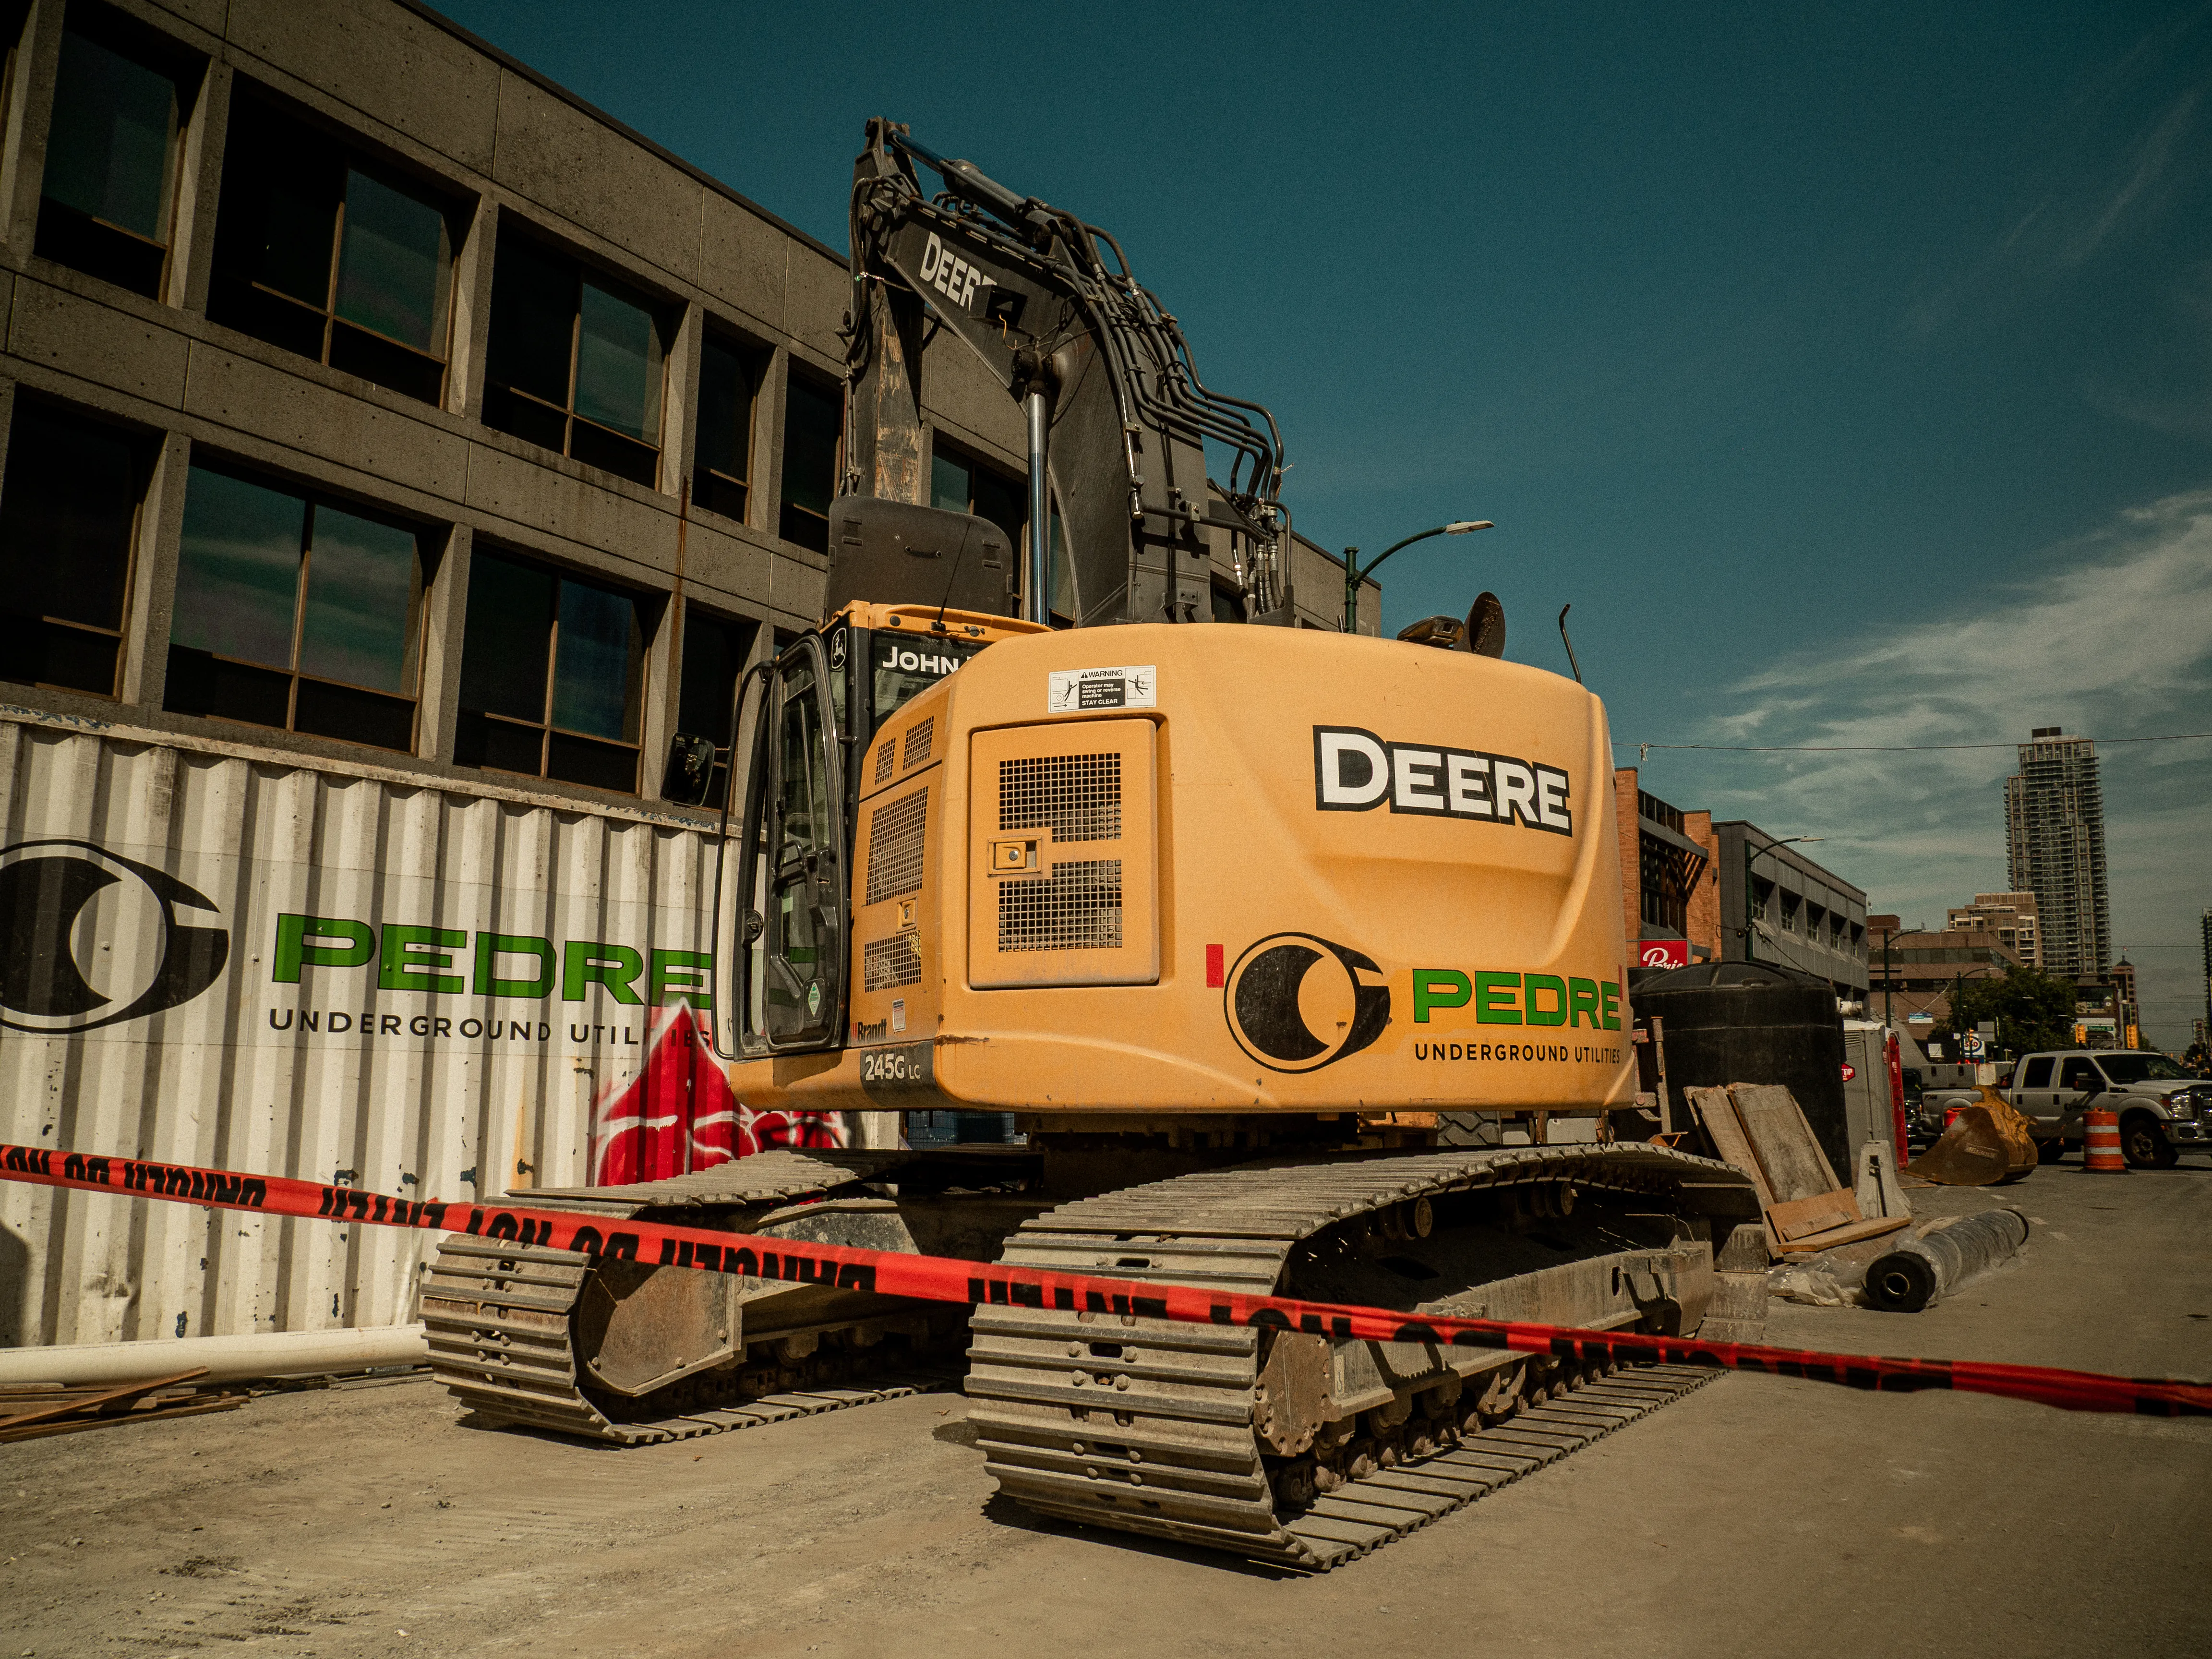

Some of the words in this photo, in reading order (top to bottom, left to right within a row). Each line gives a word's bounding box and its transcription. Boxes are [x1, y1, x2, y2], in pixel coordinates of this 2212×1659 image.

[920, 231, 998, 312] DEER
[882, 646, 960, 674] JOHN
[1088, 670, 1123, 678] WARNING
[1315, 727, 1571, 834] DEERE
[272, 913, 712, 1010] PEDRE
[1412, 968, 1622, 1032] PEDRE
[269, 1008, 552, 1042] UNDERGROUND
[857, 1018, 887, 1042] Brandt
[865, 1053, 904, 1081] 245G
[908, 1064, 920, 1079] LC
[1415, 1044, 1568, 1062] UNDERGROUND
[1575, 1046, 1621, 1064] UTILITIES
